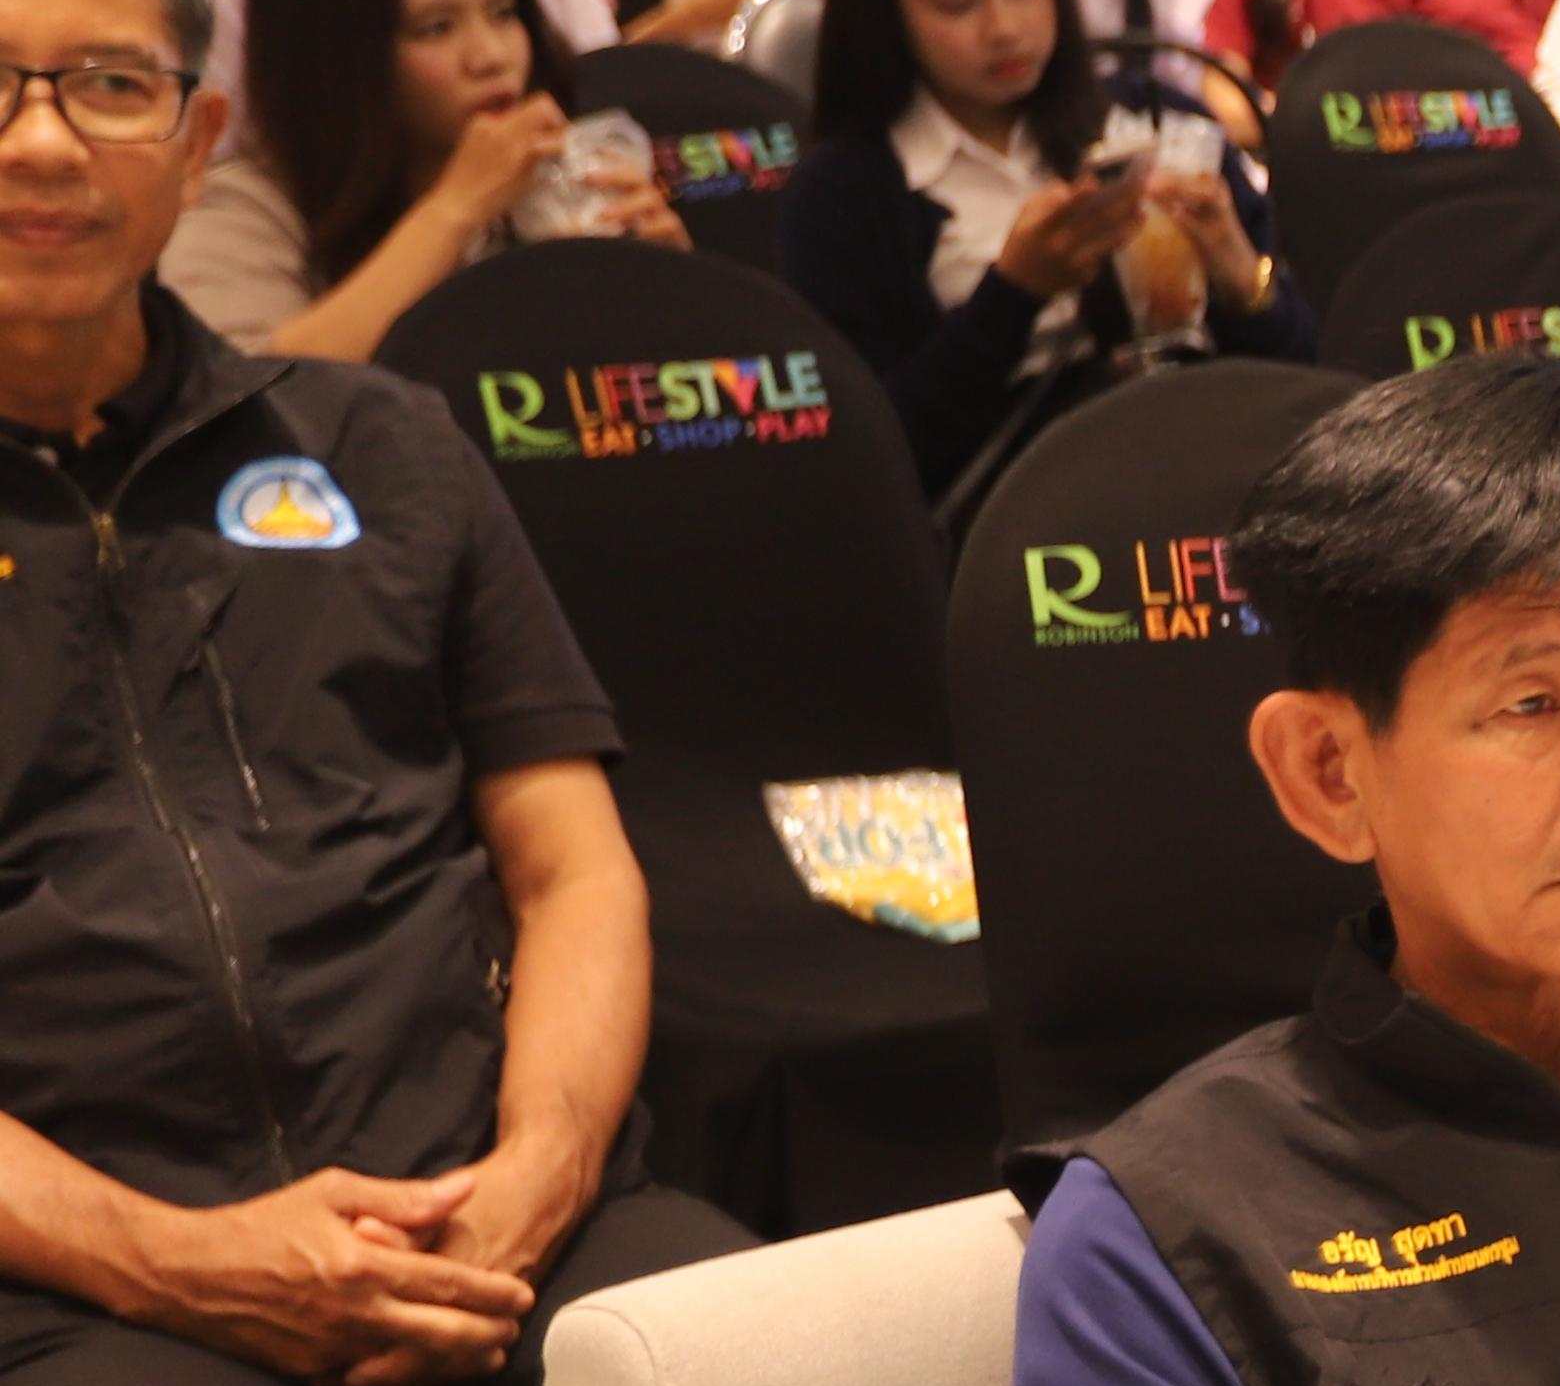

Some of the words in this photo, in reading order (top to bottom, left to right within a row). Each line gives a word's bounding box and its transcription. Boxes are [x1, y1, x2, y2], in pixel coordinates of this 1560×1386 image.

[564, 350, 828, 423] LIFESTYLE
[654, 416, 743, 453] SHOP
[755, 406, 832, 444] PLAY
[1144, 602, 1213, 642] EAT
